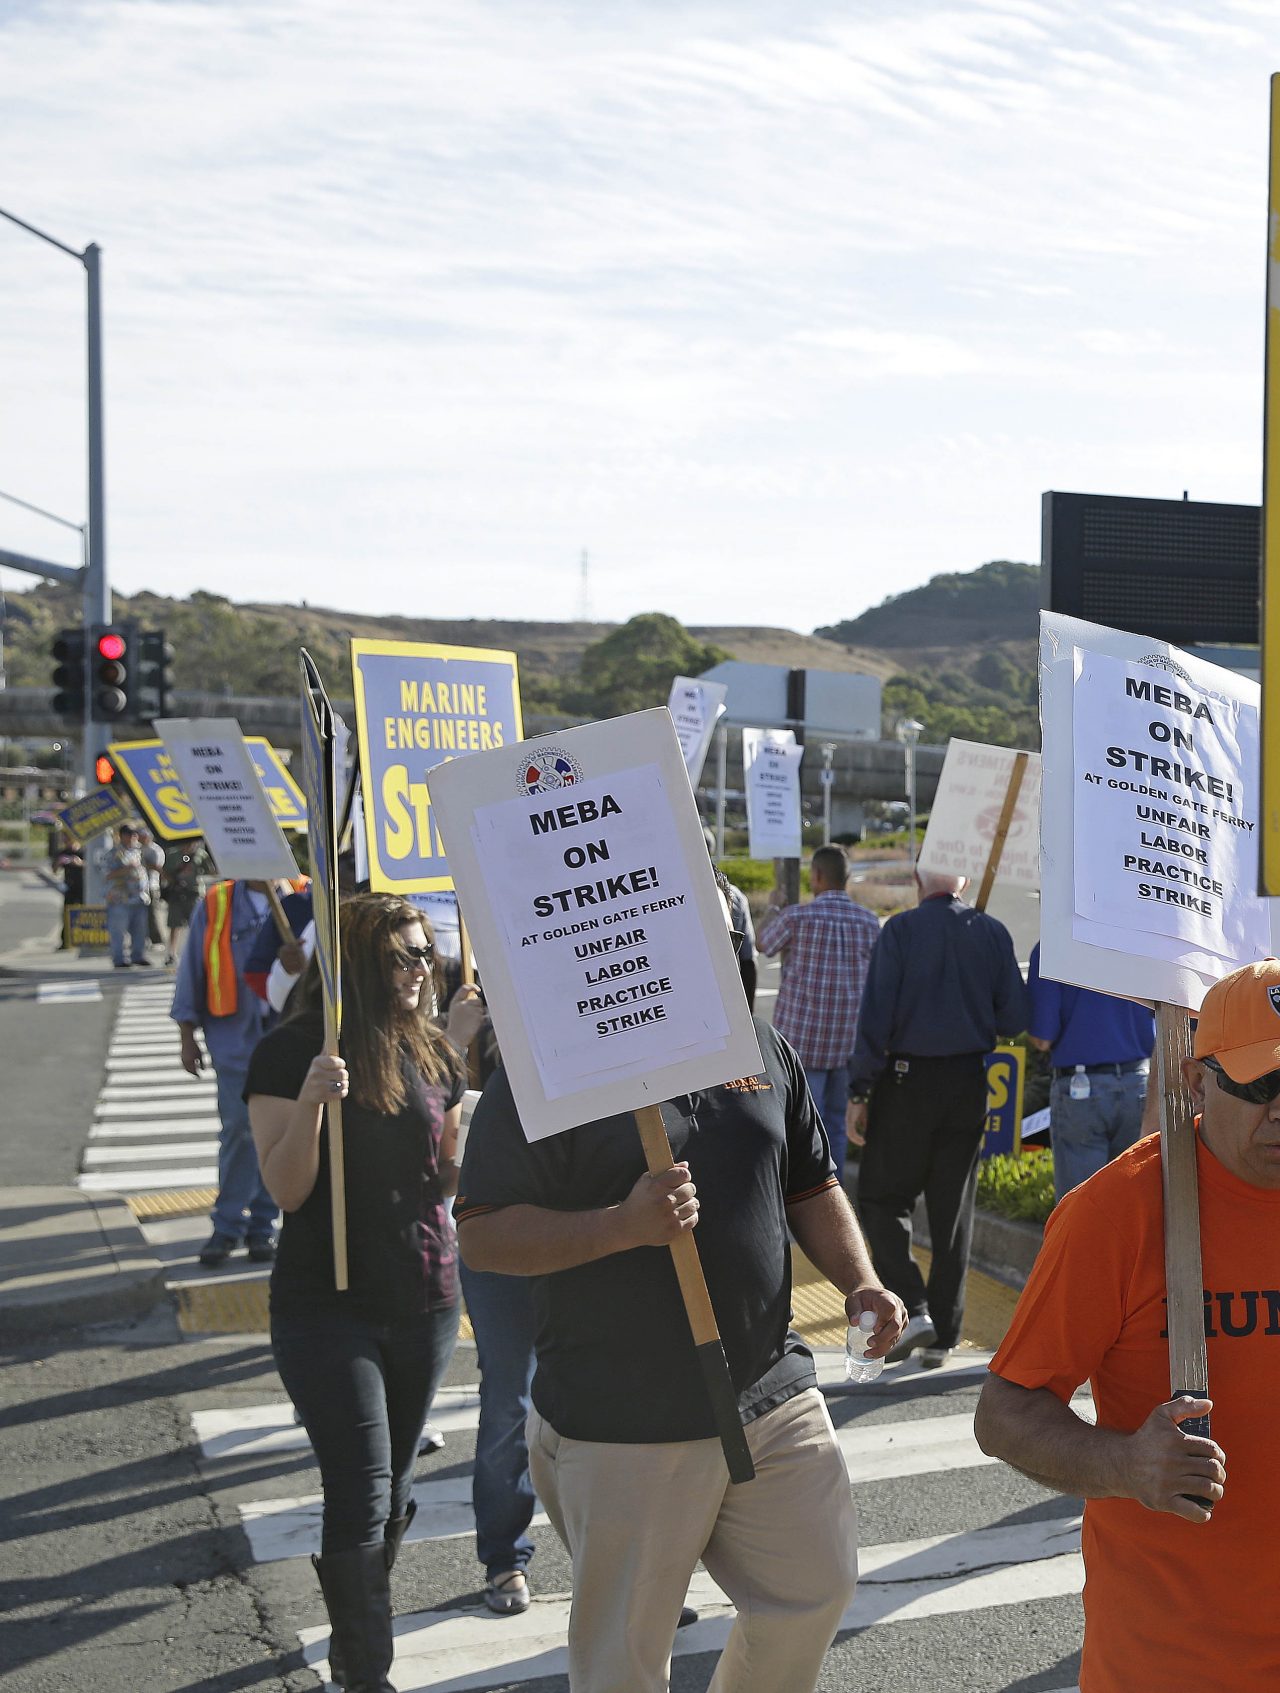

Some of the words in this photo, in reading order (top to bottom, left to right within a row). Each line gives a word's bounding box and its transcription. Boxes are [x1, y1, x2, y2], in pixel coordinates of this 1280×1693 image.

[400, 680, 487, 715] MARINE
[1125, 678, 1214, 725] MEBA
[384, 716, 504, 751] ENGINEERS
[1148, 721, 1193, 751] ON
[1105, 747, 1234, 802] STRIKE!
[529, 793, 622, 836] MEBA
[1084, 773, 1103, 785] AT
[1107, 779, 1168, 800] GOLDEN
[1172, 794, 1208, 814] GATE
[1212, 810, 1256, 832] FERRY
[1136, 805, 1211, 840] UNFAIR
[563, 839, 610, 868] ON
[1140, 832, 1208, 864] LABOR
[533, 867, 660, 918] STRIKE!
[1124, 855, 1223, 897] PRACTICE
[1138, 883, 1212, 917] STRIKE
[521, 934, 539, 947] AT
[543, 919, 600, 941] GOLDEN
[603, 908, 639, 925] GATE
[643, 895, 686, 914] FERRY
[574, 928, 648, 960] UNFAIR
[585, 955, 651, 985] LABOR
[577, 977, 673, 1015] PRACTICE
[596, 1004, 667, 1036] STRIKE
